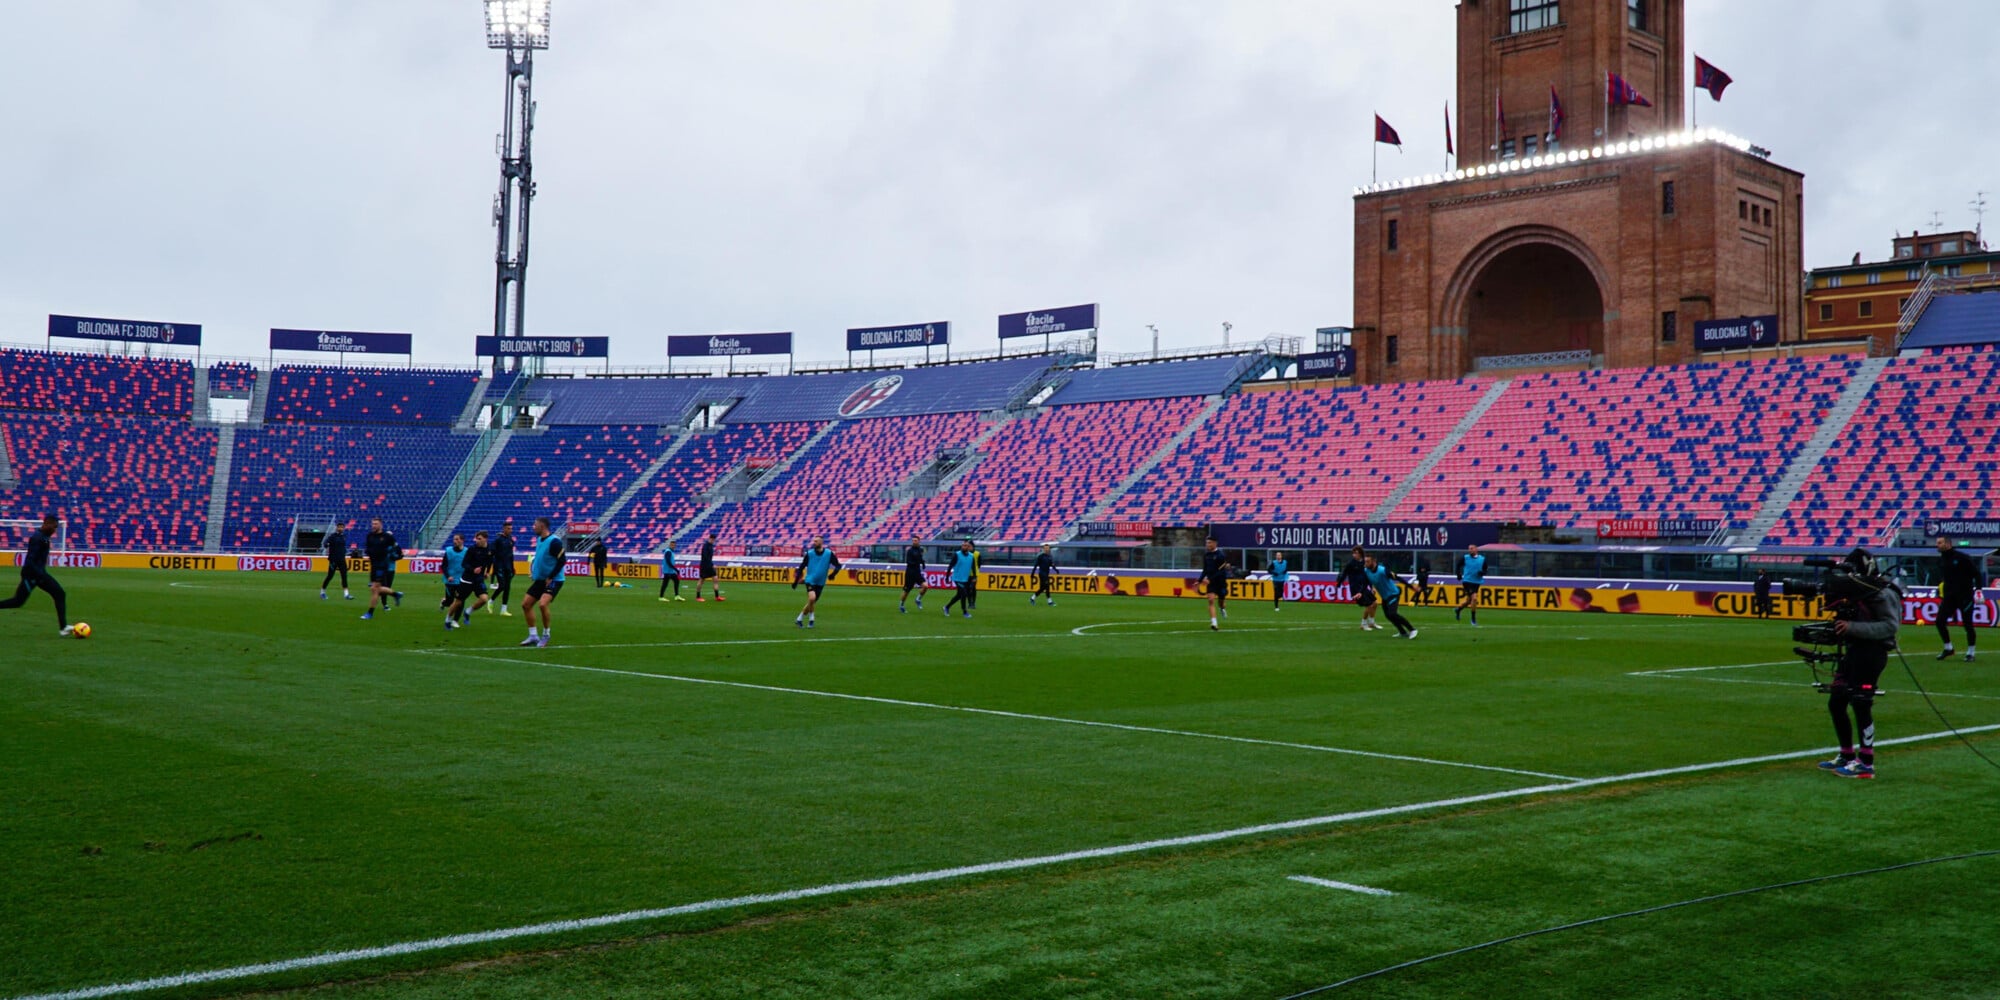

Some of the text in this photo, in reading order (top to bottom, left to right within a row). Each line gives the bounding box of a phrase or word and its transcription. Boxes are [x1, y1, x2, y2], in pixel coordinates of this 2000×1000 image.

[77, 321, 158, 338] BOLOGNA FC 1909
[1026, 322, 1065, 334] ristrutturare
[1704, 326, 1740, 340] BOLOGNA
[861, 328, 922, 345] BOLOGNA FC 1909
[318, 343, 366, 352] ristrutturare
[500, 340, 537, 352] BOLOGNA
[550, 340, 571, 352] 1909
[709, 346, 751, 355] ristrutturare
[1303, 358, 1329, 370] BOLOGNA
[1612, 521, 1645, 530] CENTRO
[1647, 521, 1686, 530] BOLOGNA
[1941, 521, 1964, 533] MARCO
[1271, 527, 1431, 546] STADIO RENATO DALL'ARA
[149, 556, 216, 569] CUBETTI
[242, 556, 307, 571] Beretta
[616, 564, 652, 577] CUBETTI
[741, 568, 789, 582] PERFETTA
[856, 570, 904, 586] CUBETTI
[988, 574, 1097, 592] PIZZA PRFETTA
[1455, 587, 1558, 608] PRFETTA
